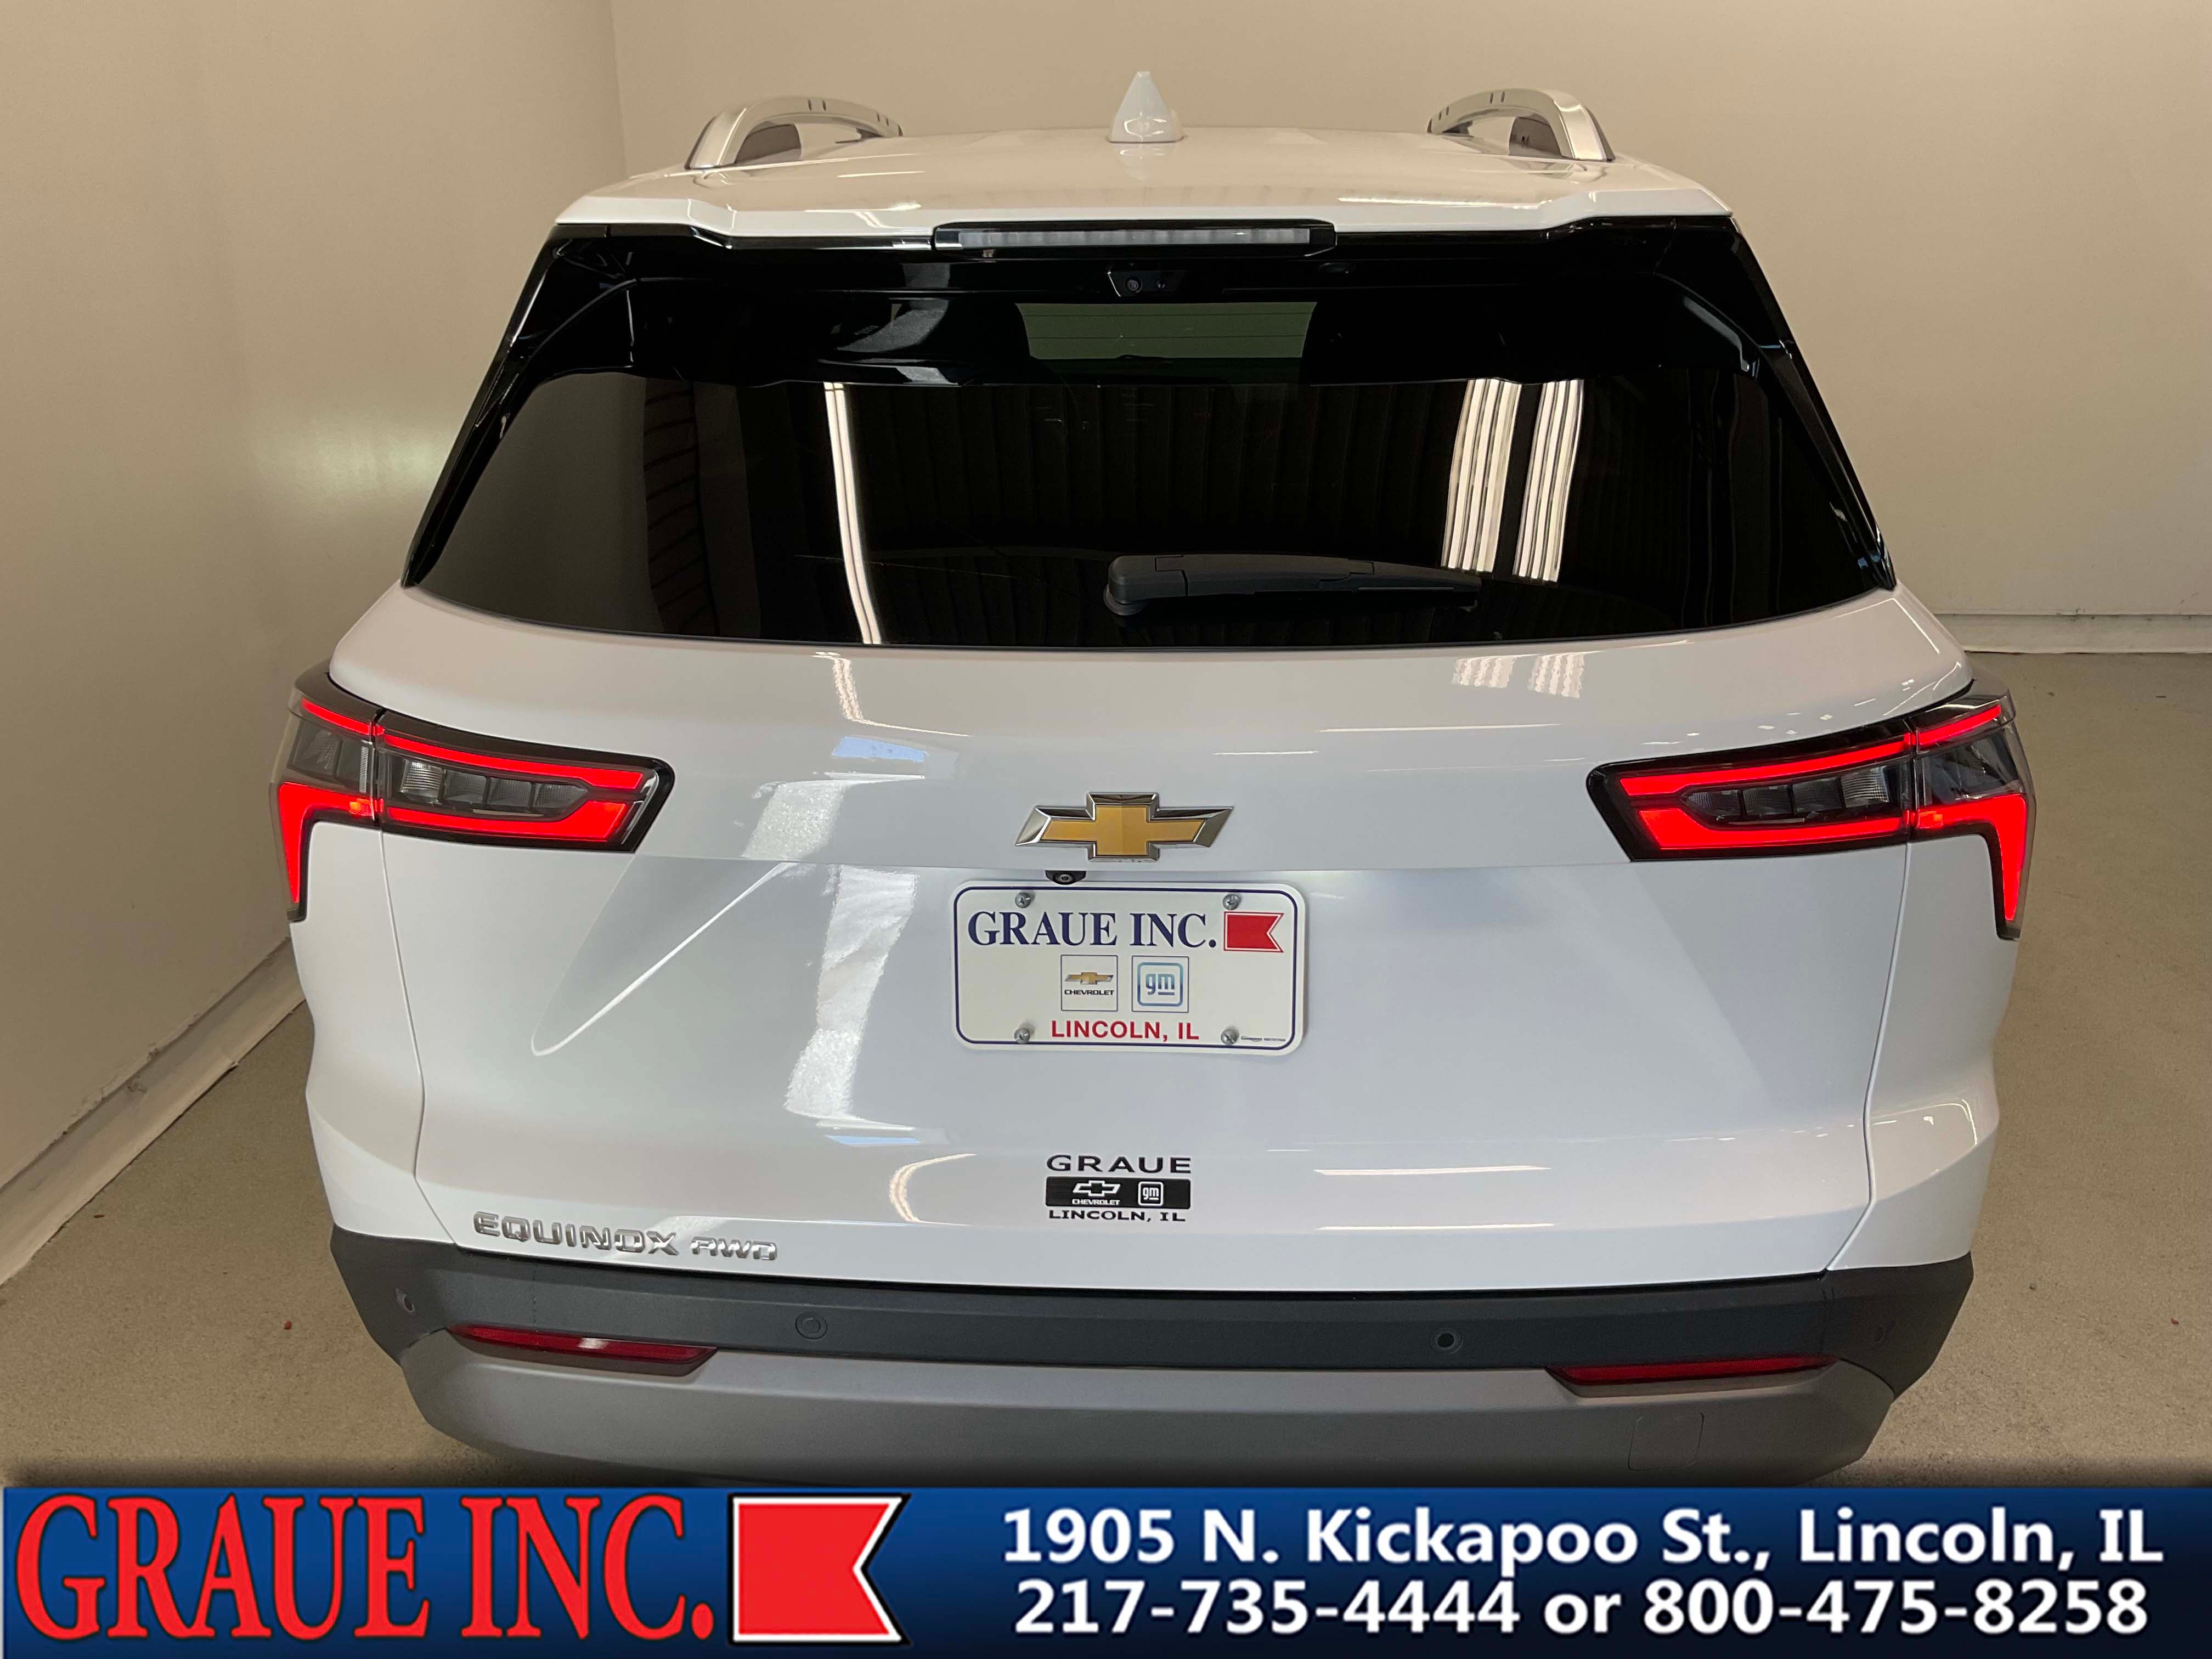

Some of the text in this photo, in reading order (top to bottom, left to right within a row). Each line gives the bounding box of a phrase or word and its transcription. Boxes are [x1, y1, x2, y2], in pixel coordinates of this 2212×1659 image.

[967, 911, 1217, 949] GRAUE INC.
[1146, 973, 1175, 997] gm
[1051, 1020, 1199, 1042] LINCOLN, IL
[1047, 1155, 1191, 1173] GRAUE
[1049, 1210, 1186, 1222] LINCOLN, IL
[473, 1211, 777, 1261] EQUINOX AWD
